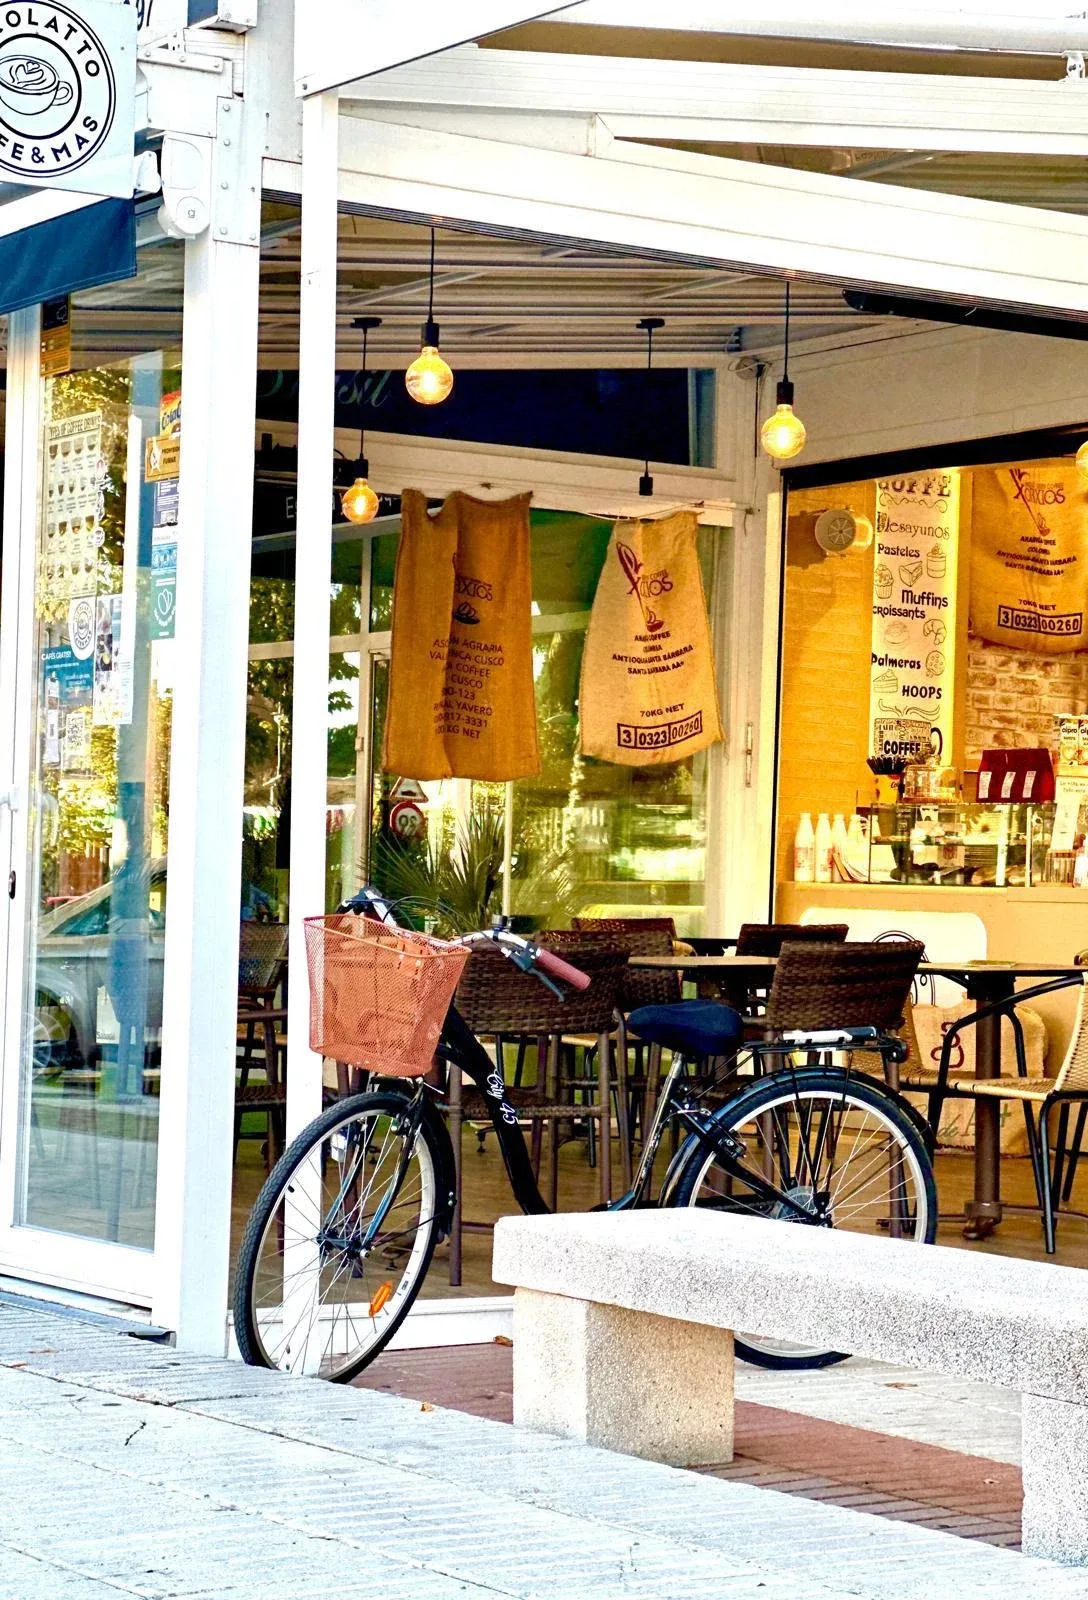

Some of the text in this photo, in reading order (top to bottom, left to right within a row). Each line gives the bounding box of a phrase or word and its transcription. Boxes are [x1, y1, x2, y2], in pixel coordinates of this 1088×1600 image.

[0, 8, 100, 78] OLATTO
[877, 543, 920, 558] Pasteles
[901, 589, 949, 610] Muffins
[1002, 611, 1079, 631] 3 0323 00260
[474, 655, 504, 666] CUSCO
[456, 662, 491, 678] COFFEE
[451, 674, 483, 689] CUSCO
[902, 685, 942, 699] HOOPS
[455, 701, 493, 716] YAVERO
[640, 703, 685, 718] 70KG NET
[462, 726, 481, 739] NET
[622, 729, 632, 743] 3
[638, 730, 668, 746] 0323
[883, 740, 921, 756] COFFEE
[486, 1068, 520, 1125] City 45
